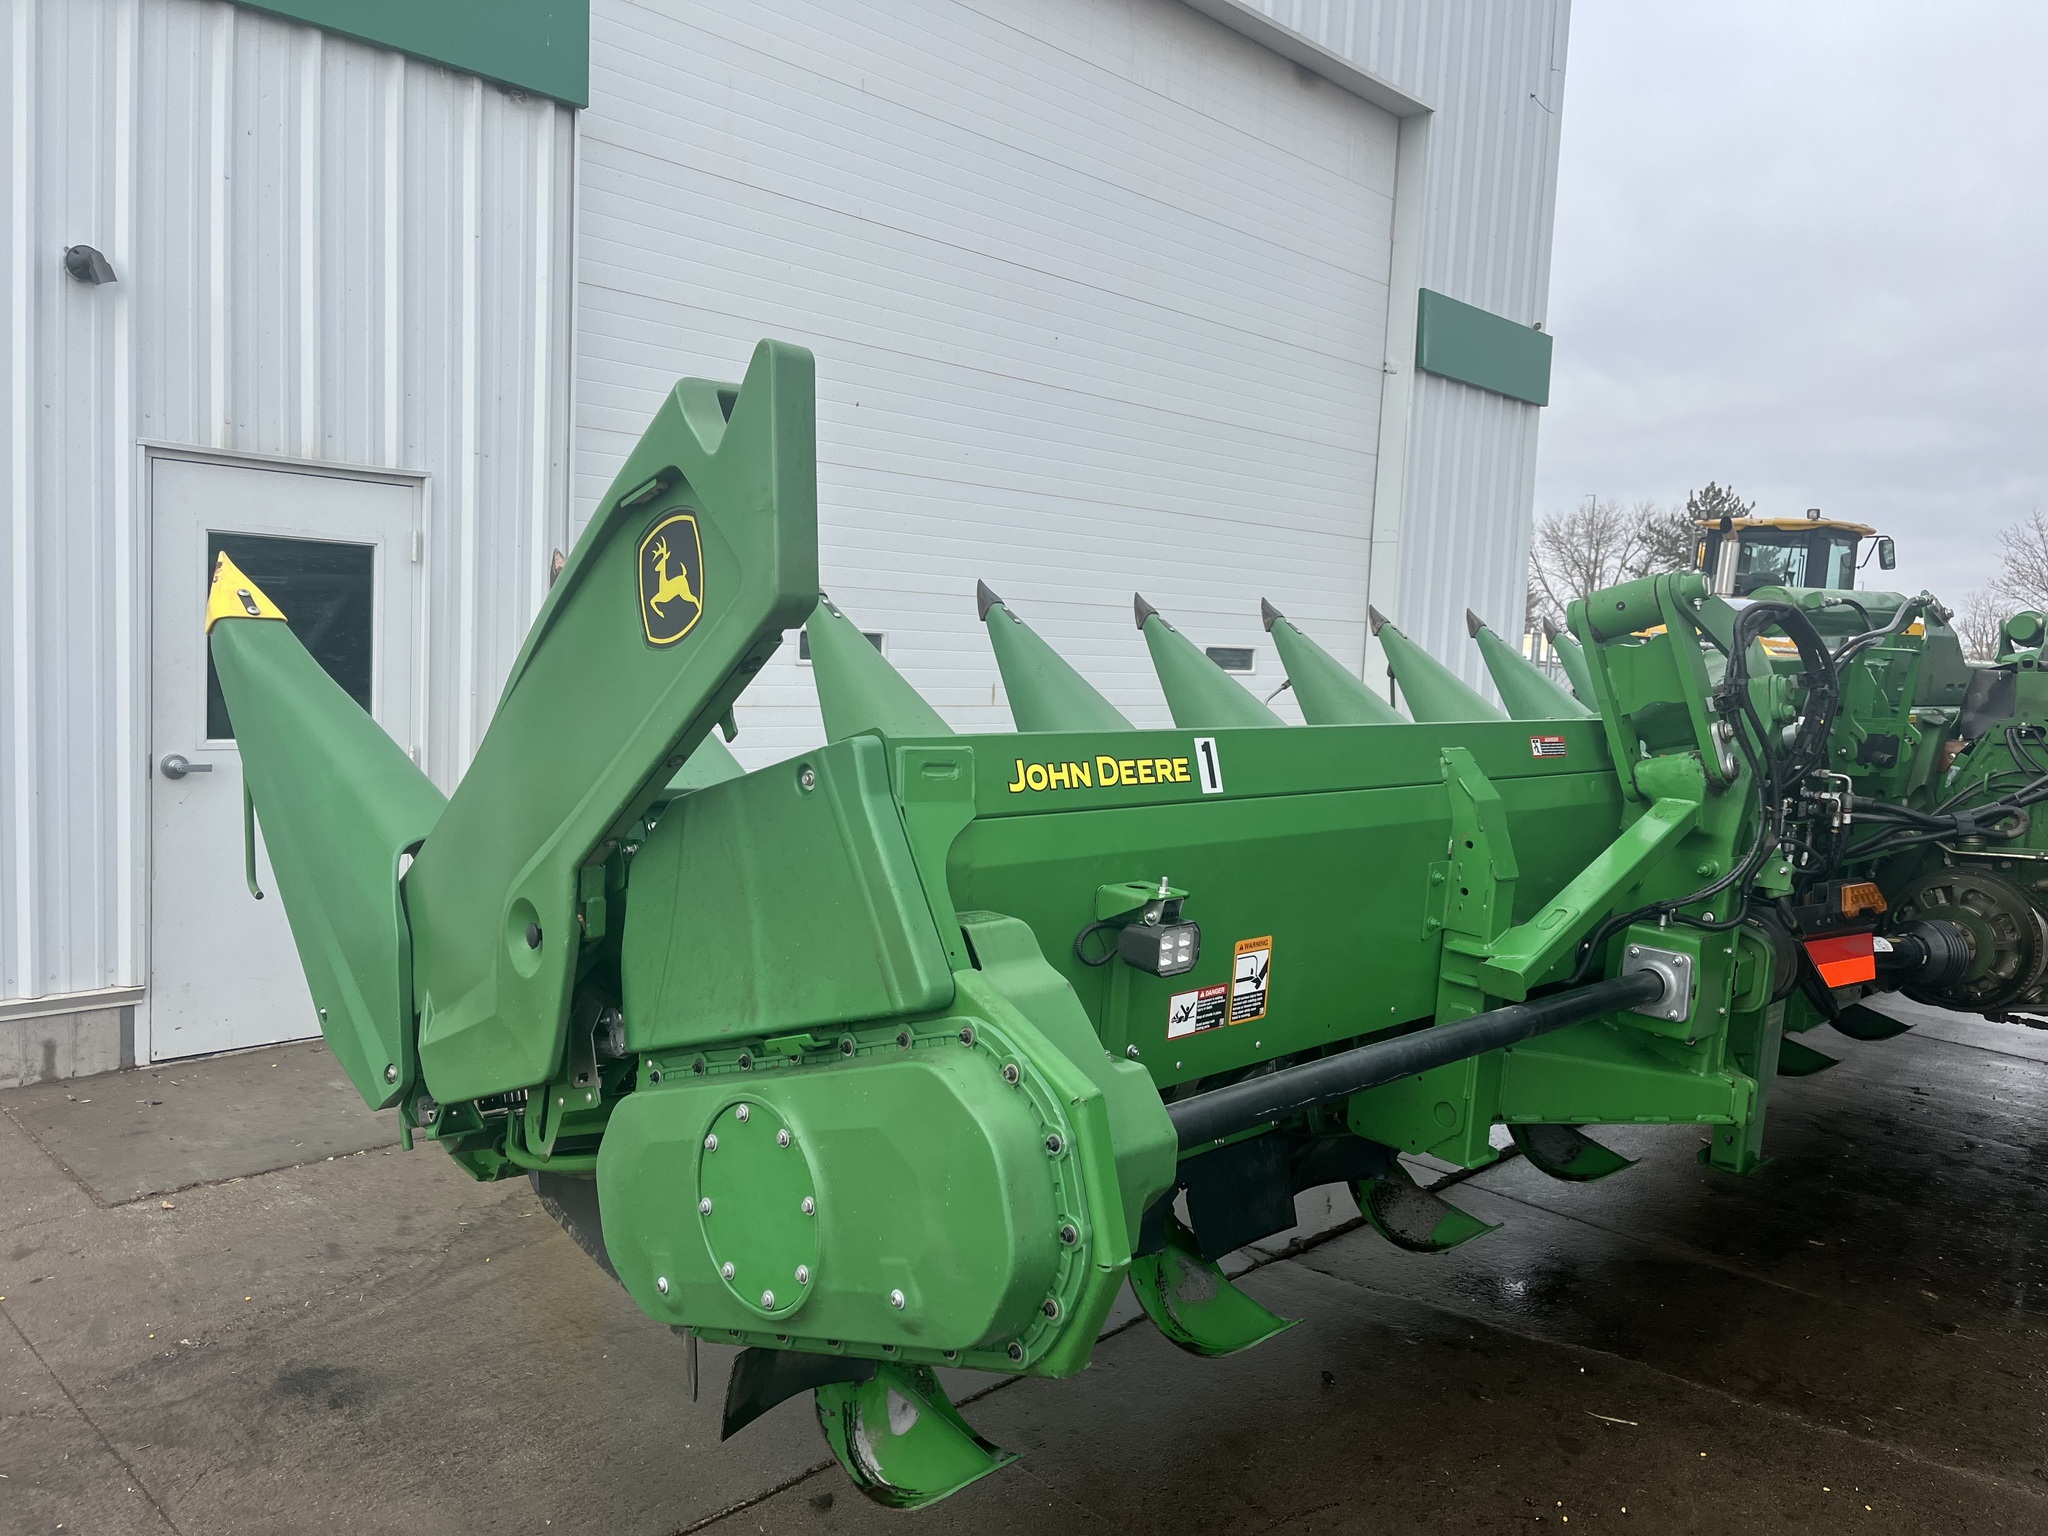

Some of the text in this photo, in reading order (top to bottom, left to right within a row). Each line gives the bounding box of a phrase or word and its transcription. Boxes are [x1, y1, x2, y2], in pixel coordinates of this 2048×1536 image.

[1009, 755, 1191, 793] JOHN DEERE
[1201, 741, 1217, 788] 1
[1244, 939, 1268, 950] WARNING
[1205, 986, 1225, 997] DANGER
